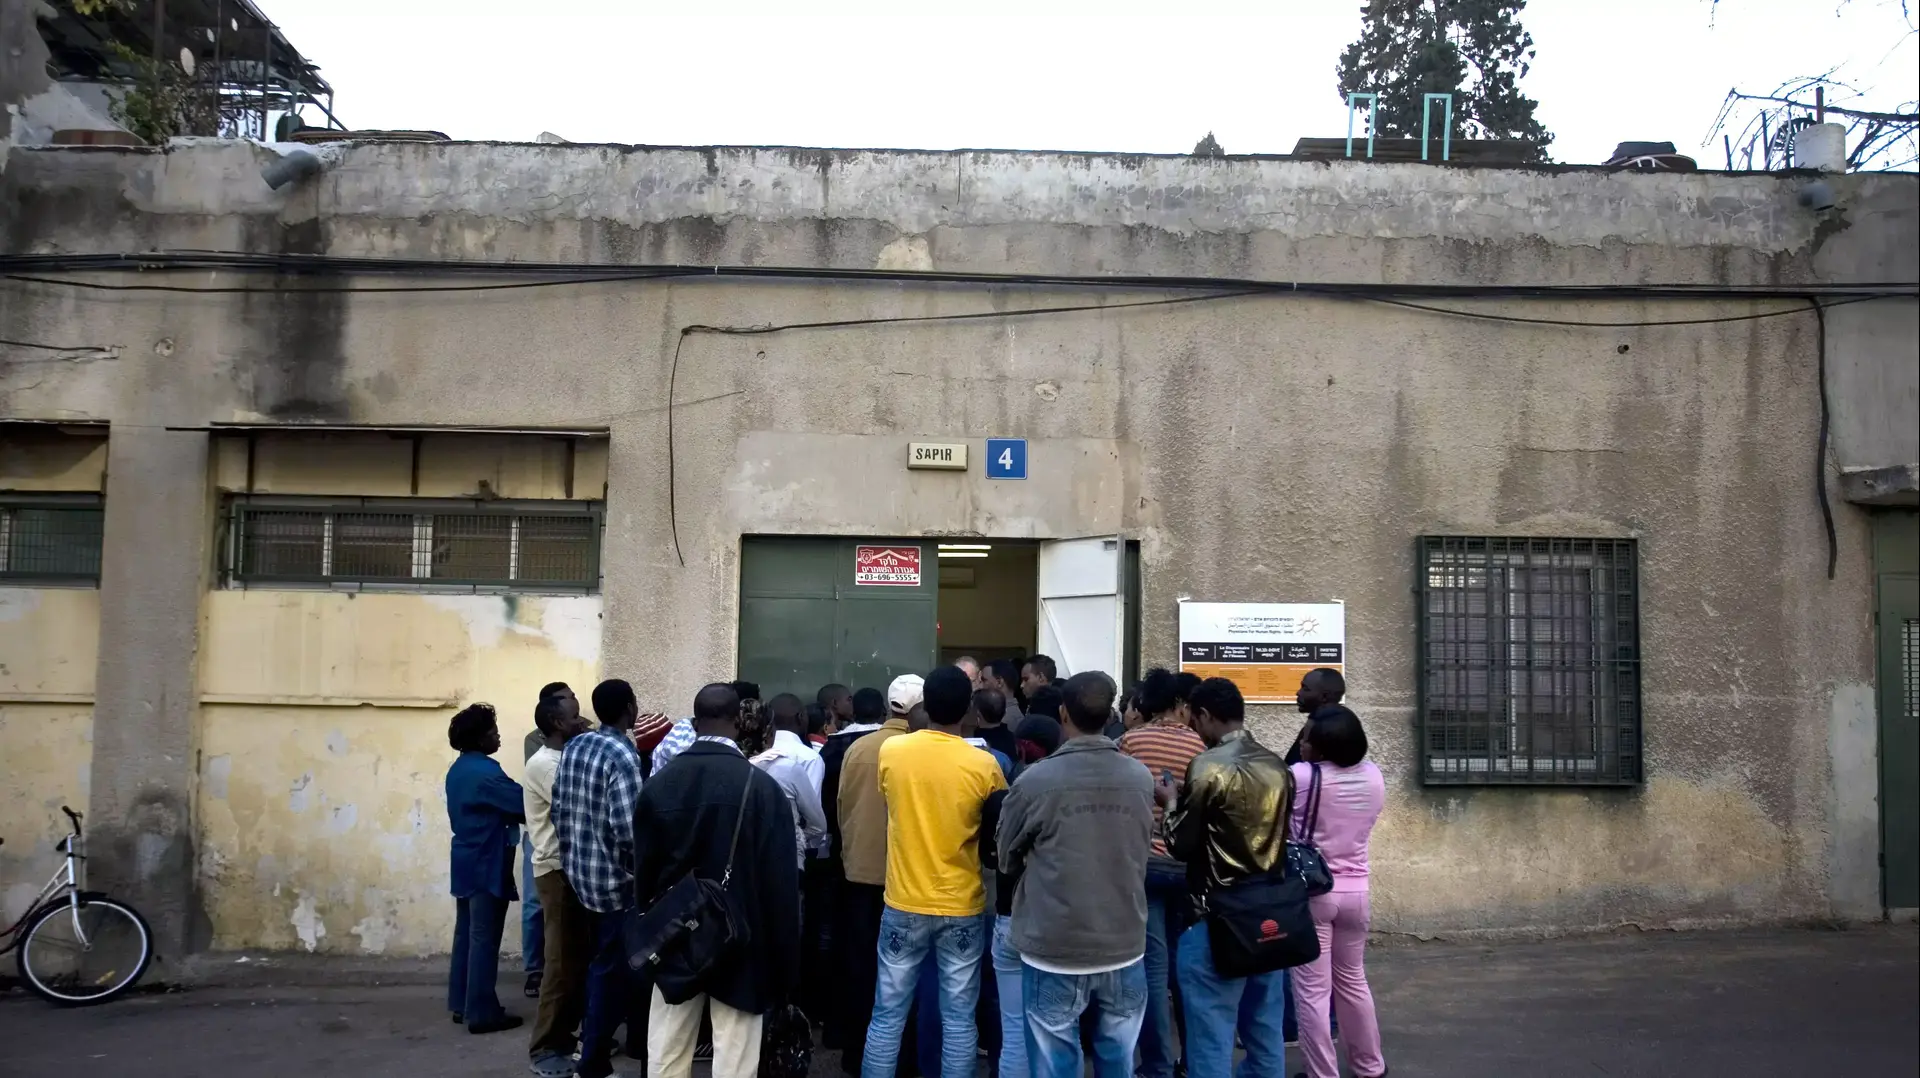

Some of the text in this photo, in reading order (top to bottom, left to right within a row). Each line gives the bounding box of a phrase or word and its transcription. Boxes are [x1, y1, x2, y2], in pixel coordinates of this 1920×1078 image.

[915, 448, 952, 461] SAPIR
[998, 447, 1013, 470] 4
[864, 573, 912, 581] 03-696-5555
